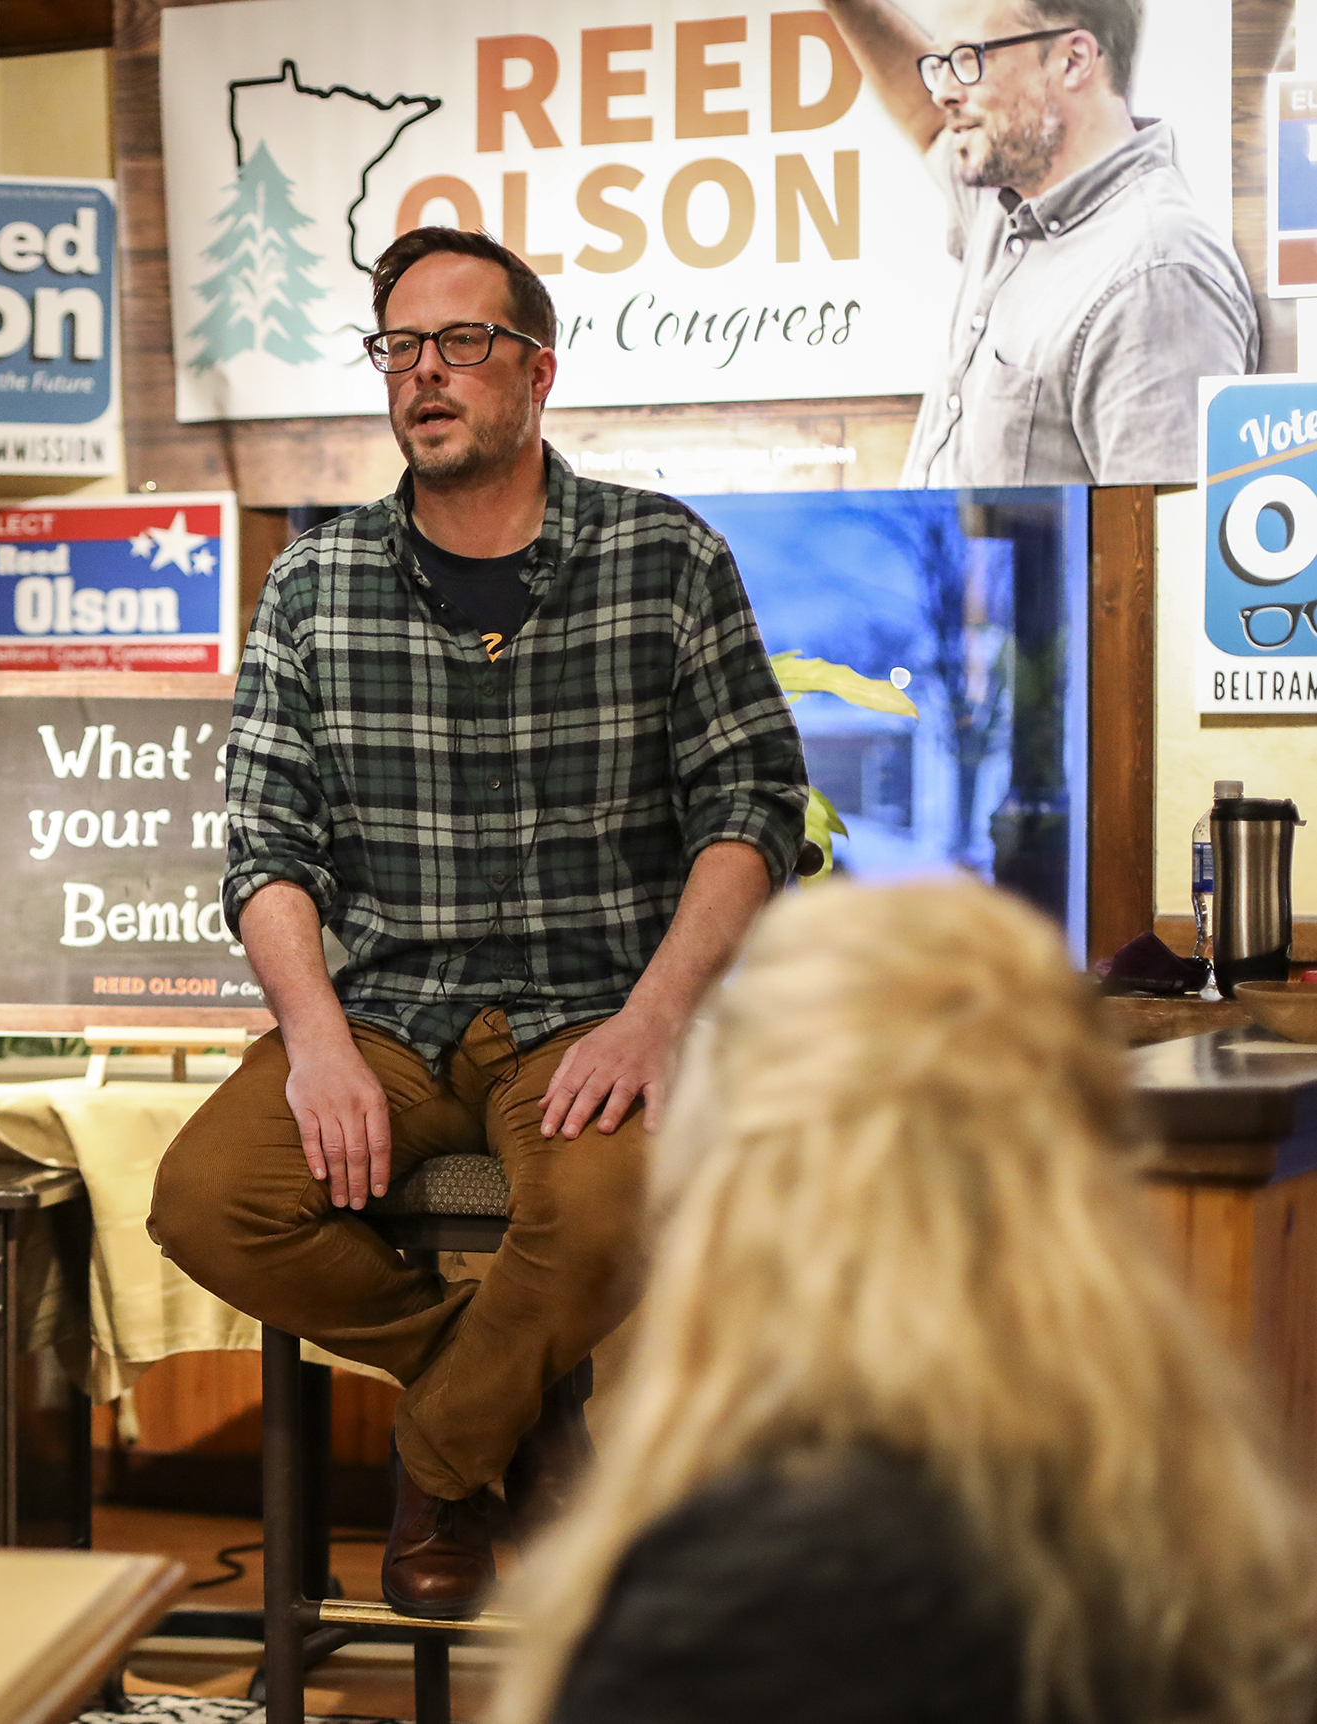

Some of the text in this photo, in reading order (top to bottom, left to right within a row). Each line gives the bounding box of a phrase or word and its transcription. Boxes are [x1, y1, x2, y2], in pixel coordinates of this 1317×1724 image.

[476, 9, 863, 153] REED
[396, 149, 860, 275] OLSON
[616, 291, 861, 370] Congress
[32, 370, 95, 394] Future
[14, 575, 180, 635] Olson
[1214, 670, 1317, 701] BELTRAM
[28, 808, 171, 860] your
[60, 877, 246, 957] Bemid
[93, 976, 146, 994] REED
[148, 977, 217, 996] OLSON
